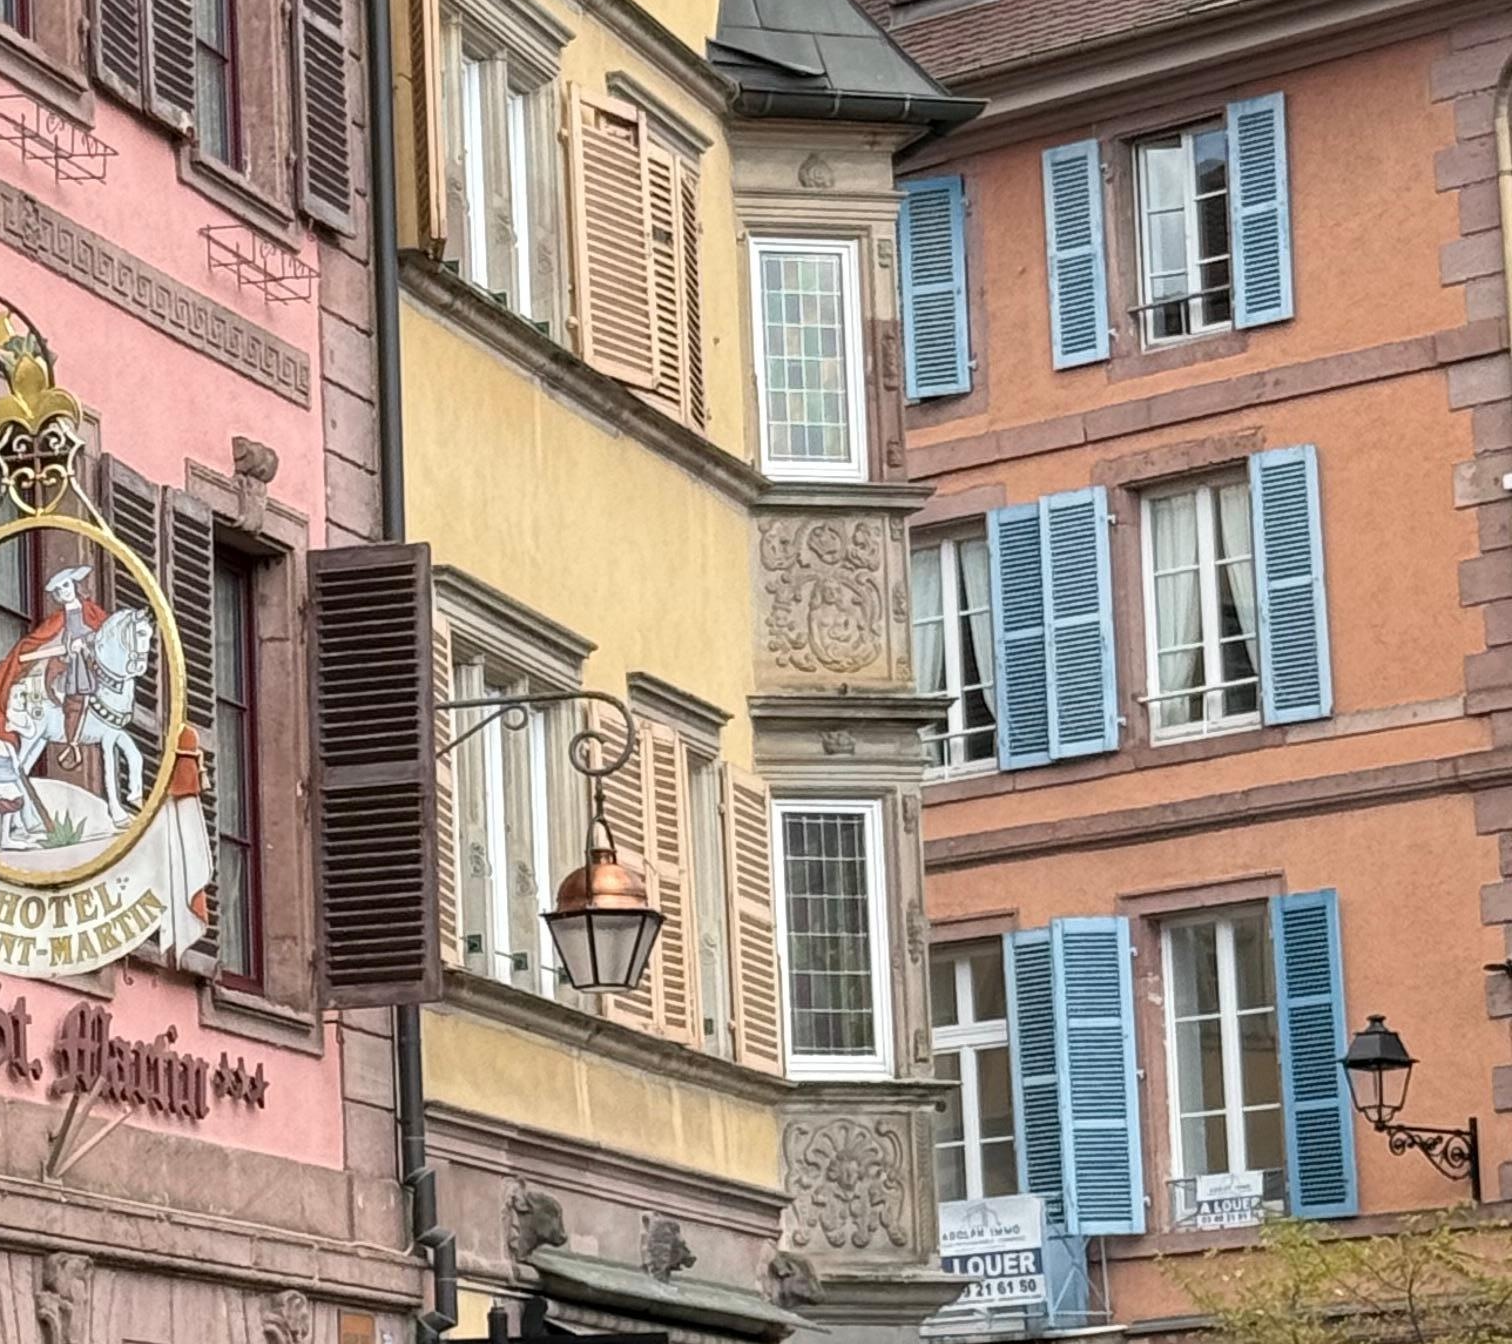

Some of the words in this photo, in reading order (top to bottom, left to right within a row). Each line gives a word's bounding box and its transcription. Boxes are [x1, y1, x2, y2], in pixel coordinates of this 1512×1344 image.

[49, 1002, 210, 1119] Martin
[975, 1282, 992, 1297] 21
[996, 1280, 1014, 1295] 61
[1019, 1278, 1037, 1292] 50
